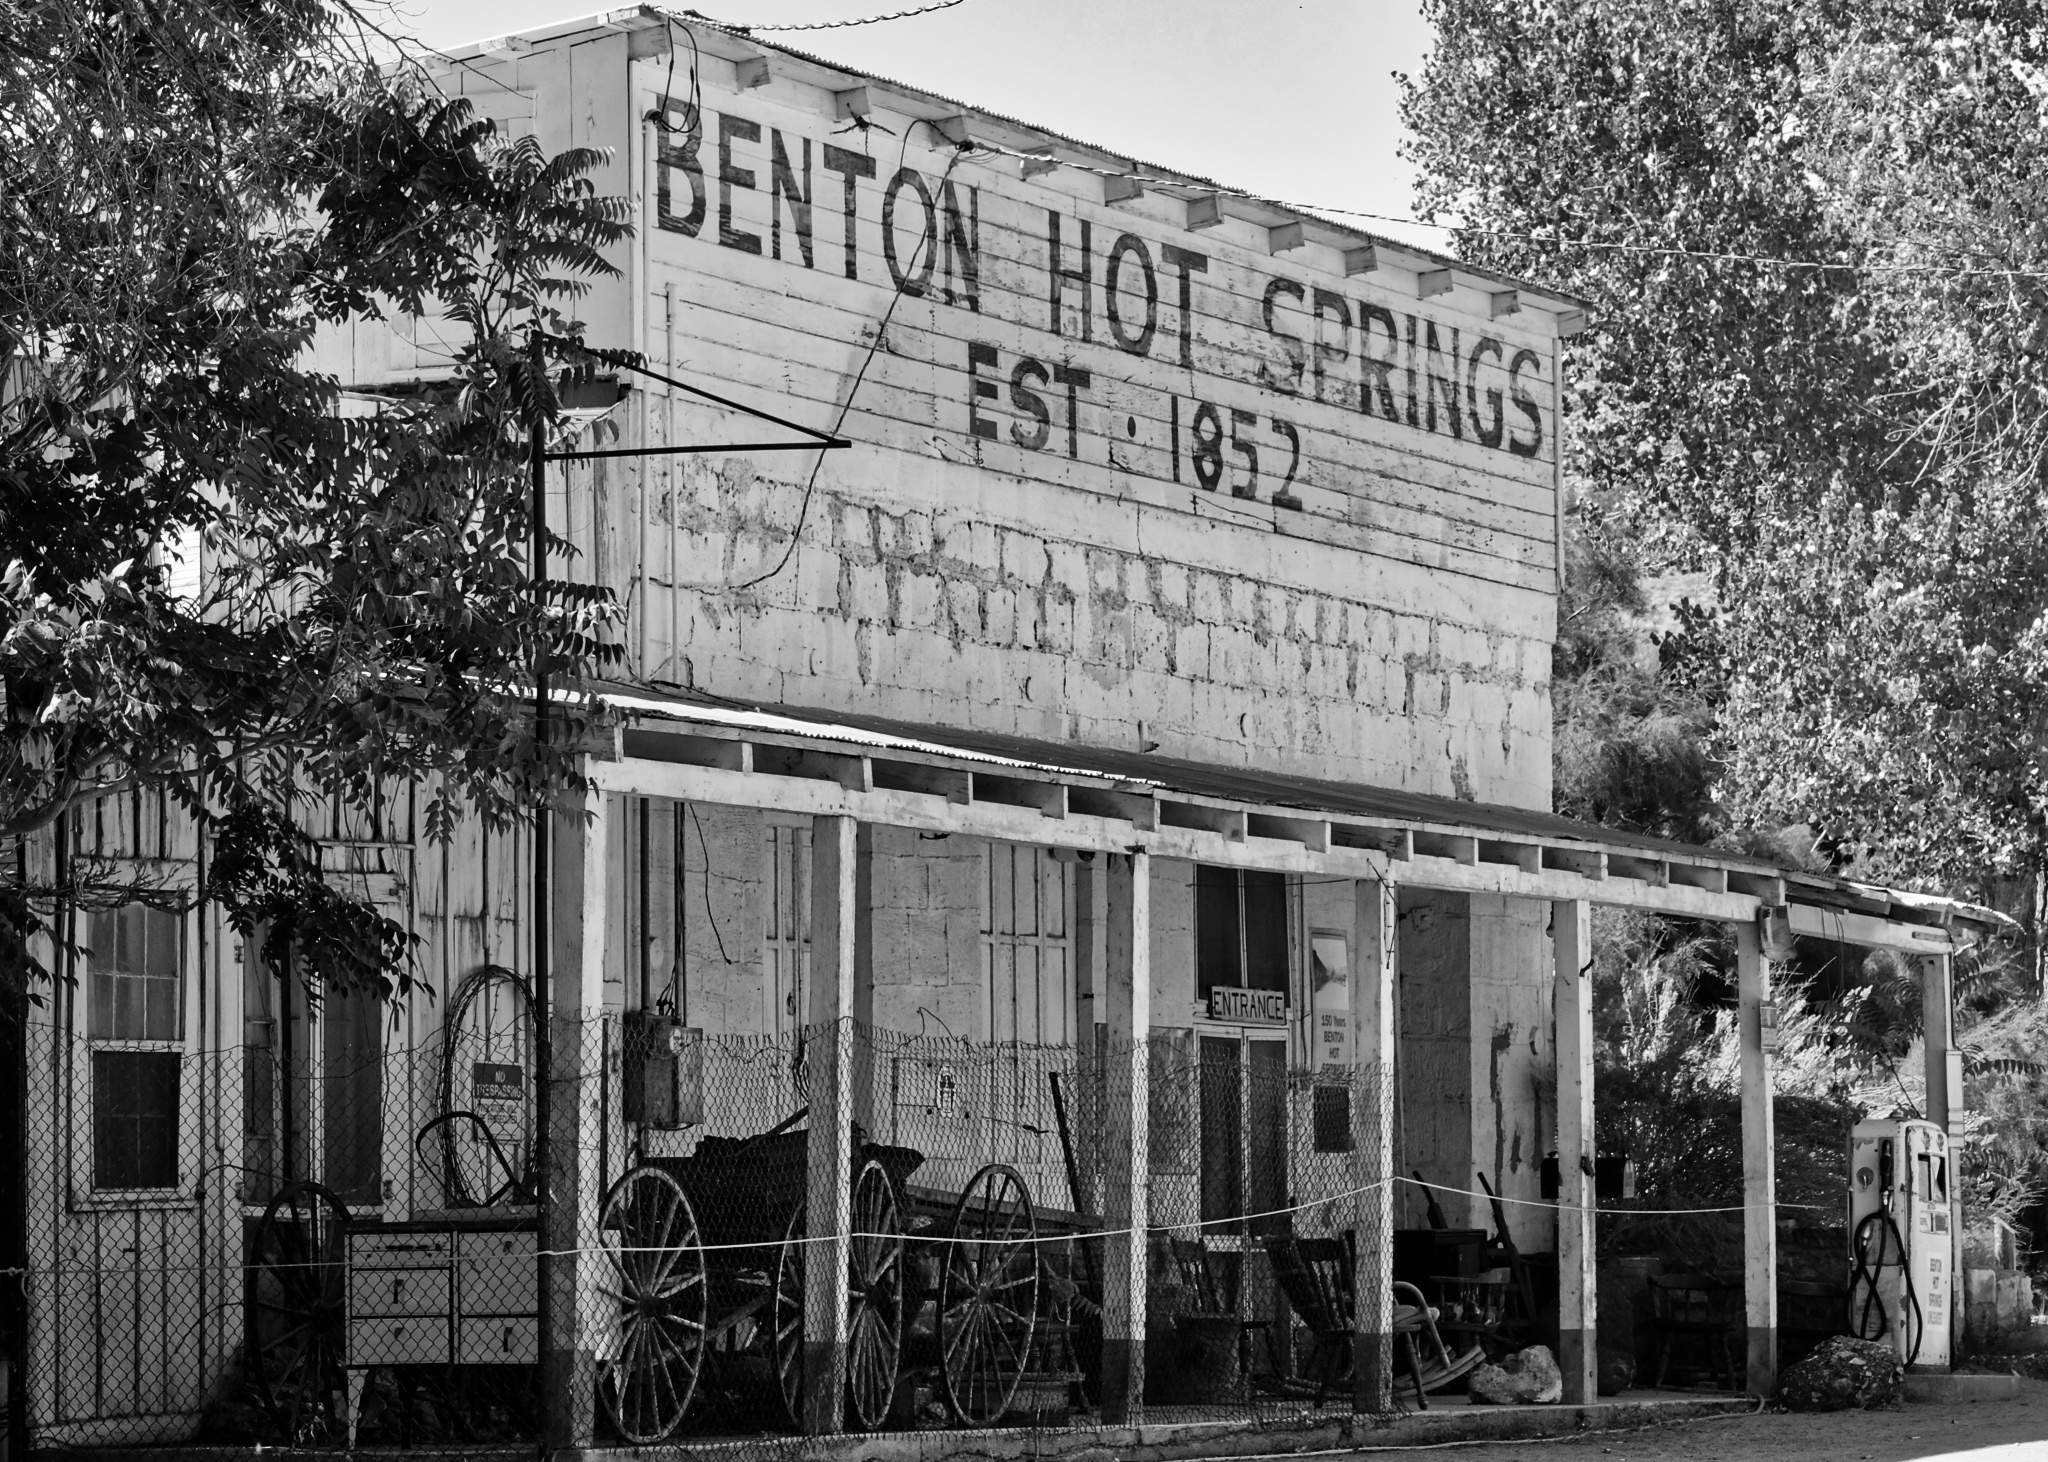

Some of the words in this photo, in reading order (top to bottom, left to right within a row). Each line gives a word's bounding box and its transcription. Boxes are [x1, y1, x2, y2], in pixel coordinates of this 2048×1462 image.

[656, 94, 979, 312] BENTON
[1048, 209, 1208, 369] HOT
[1262, 277, 1543, 459] SPRINGS
[1171, 394, 1303, 511] 1852
[1213, 991, 1284, 1021] ENTRANCE
[1321, 1014, 1333, 1027] 150
[1333, 1015, 1346, 1028] Years
[1323, 1030, 1345, 1043] BENTON
[1329, 1047, 1340, 1059] HOT
[495, 1070, 506, 1083] NO
[476, 1083, 522, 1098] TRESPASSING
